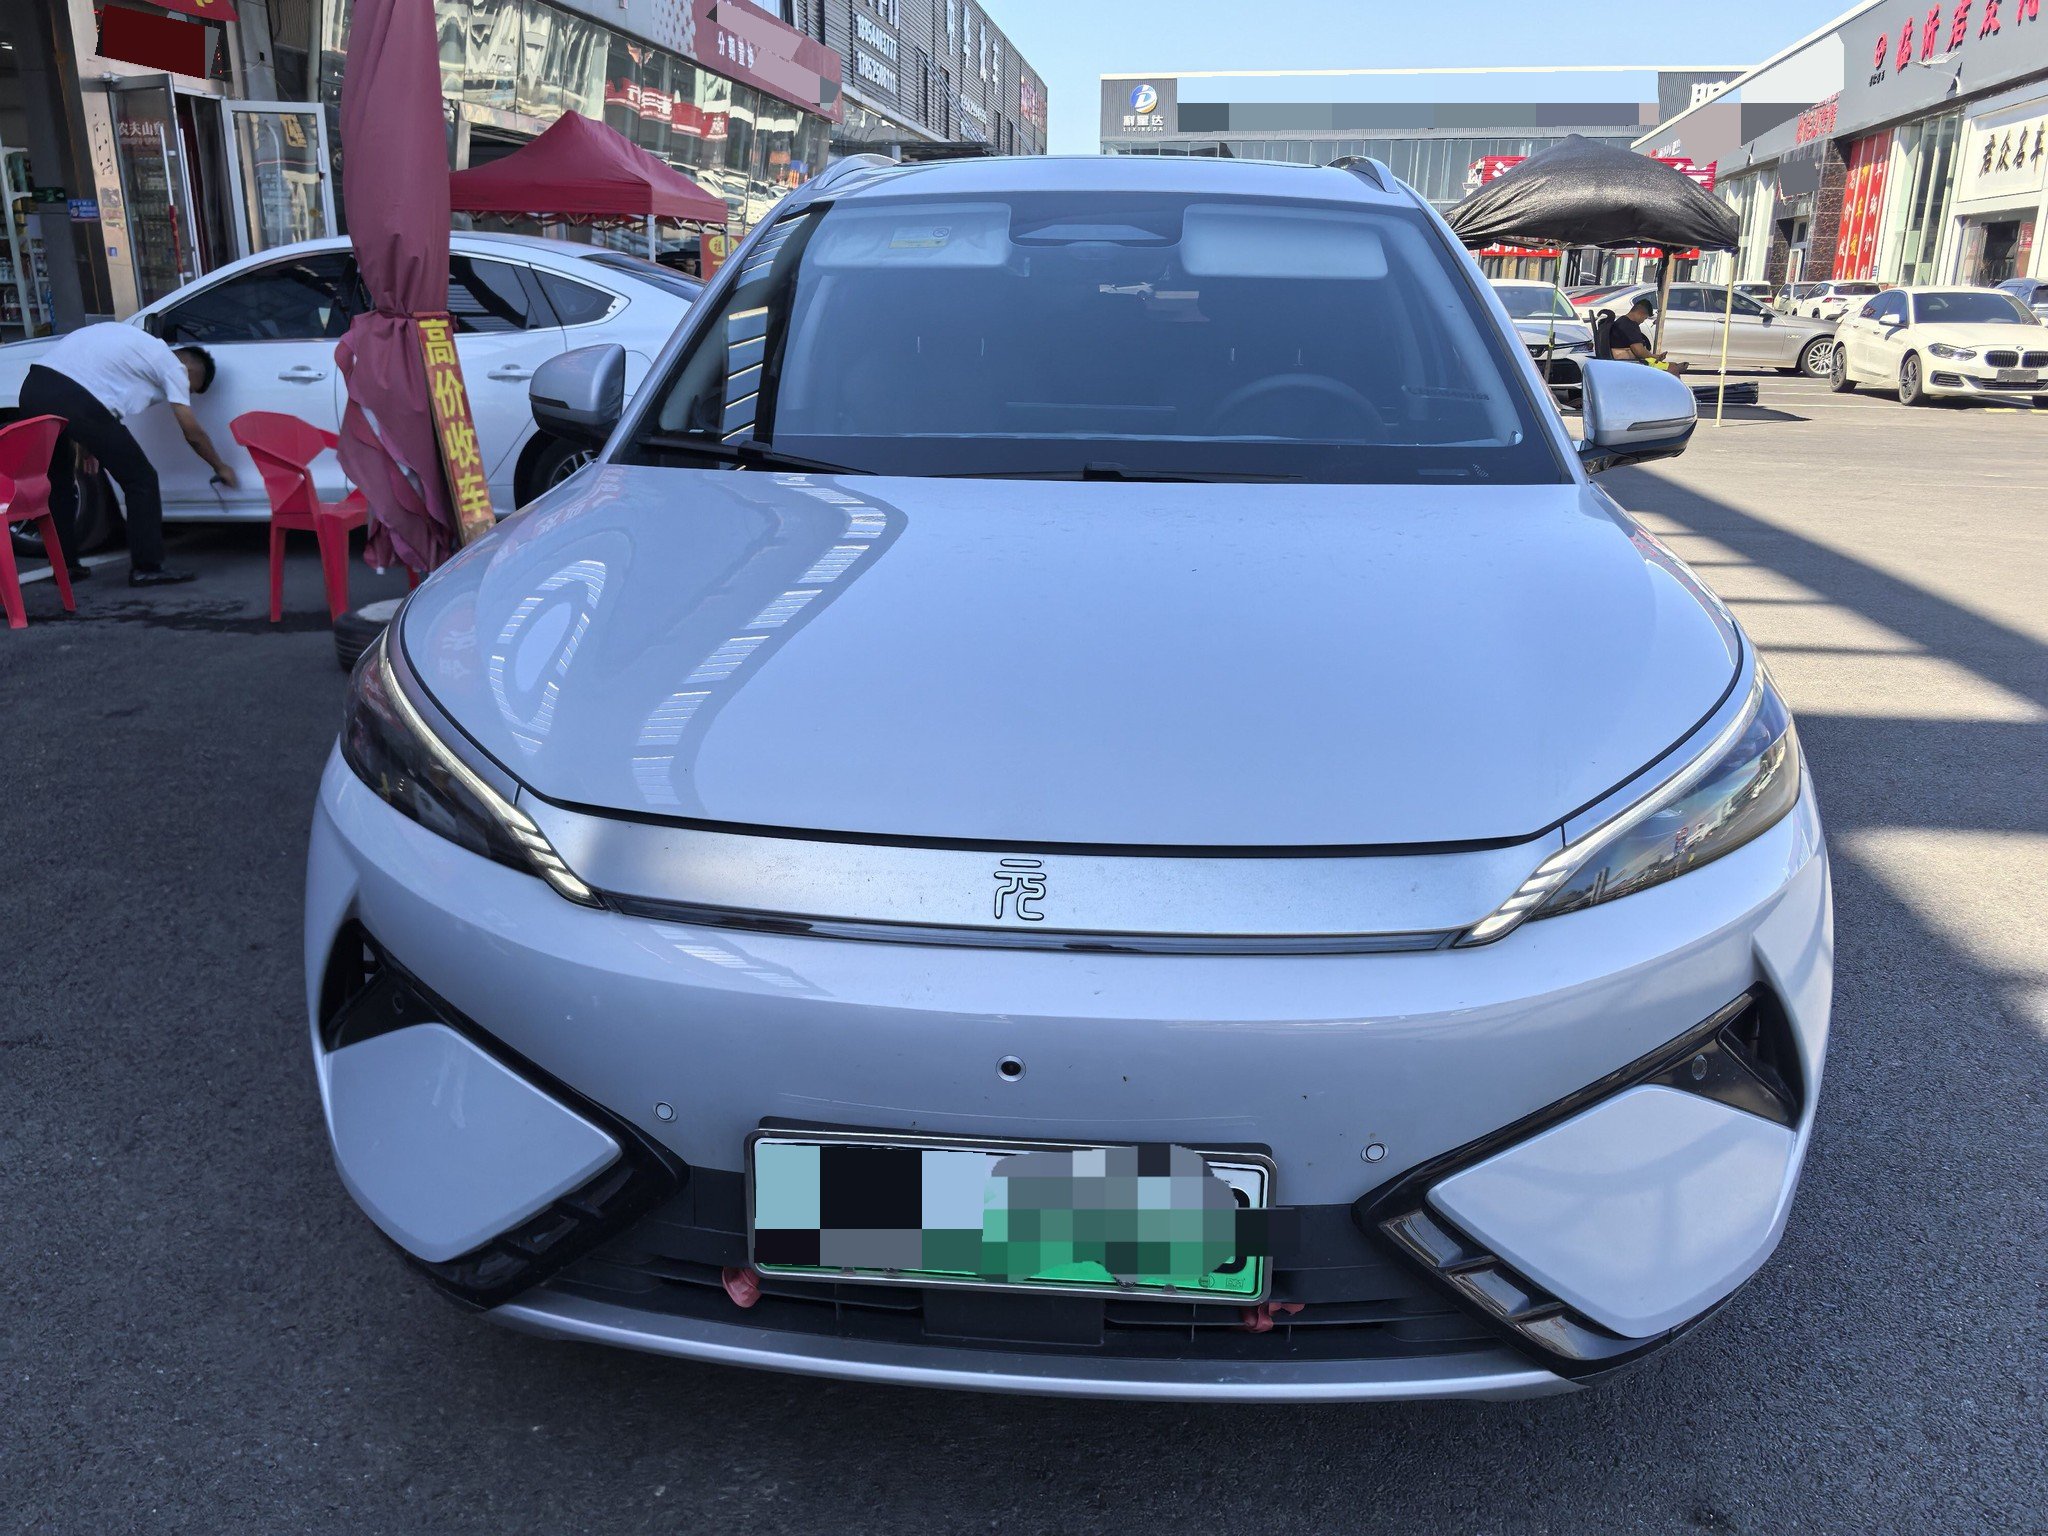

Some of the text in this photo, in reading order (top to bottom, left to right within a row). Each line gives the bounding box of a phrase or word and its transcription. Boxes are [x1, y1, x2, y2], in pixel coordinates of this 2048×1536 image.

[419, 318, 491, 518] 高价收车
[994, 858, 1047, 921] 元
